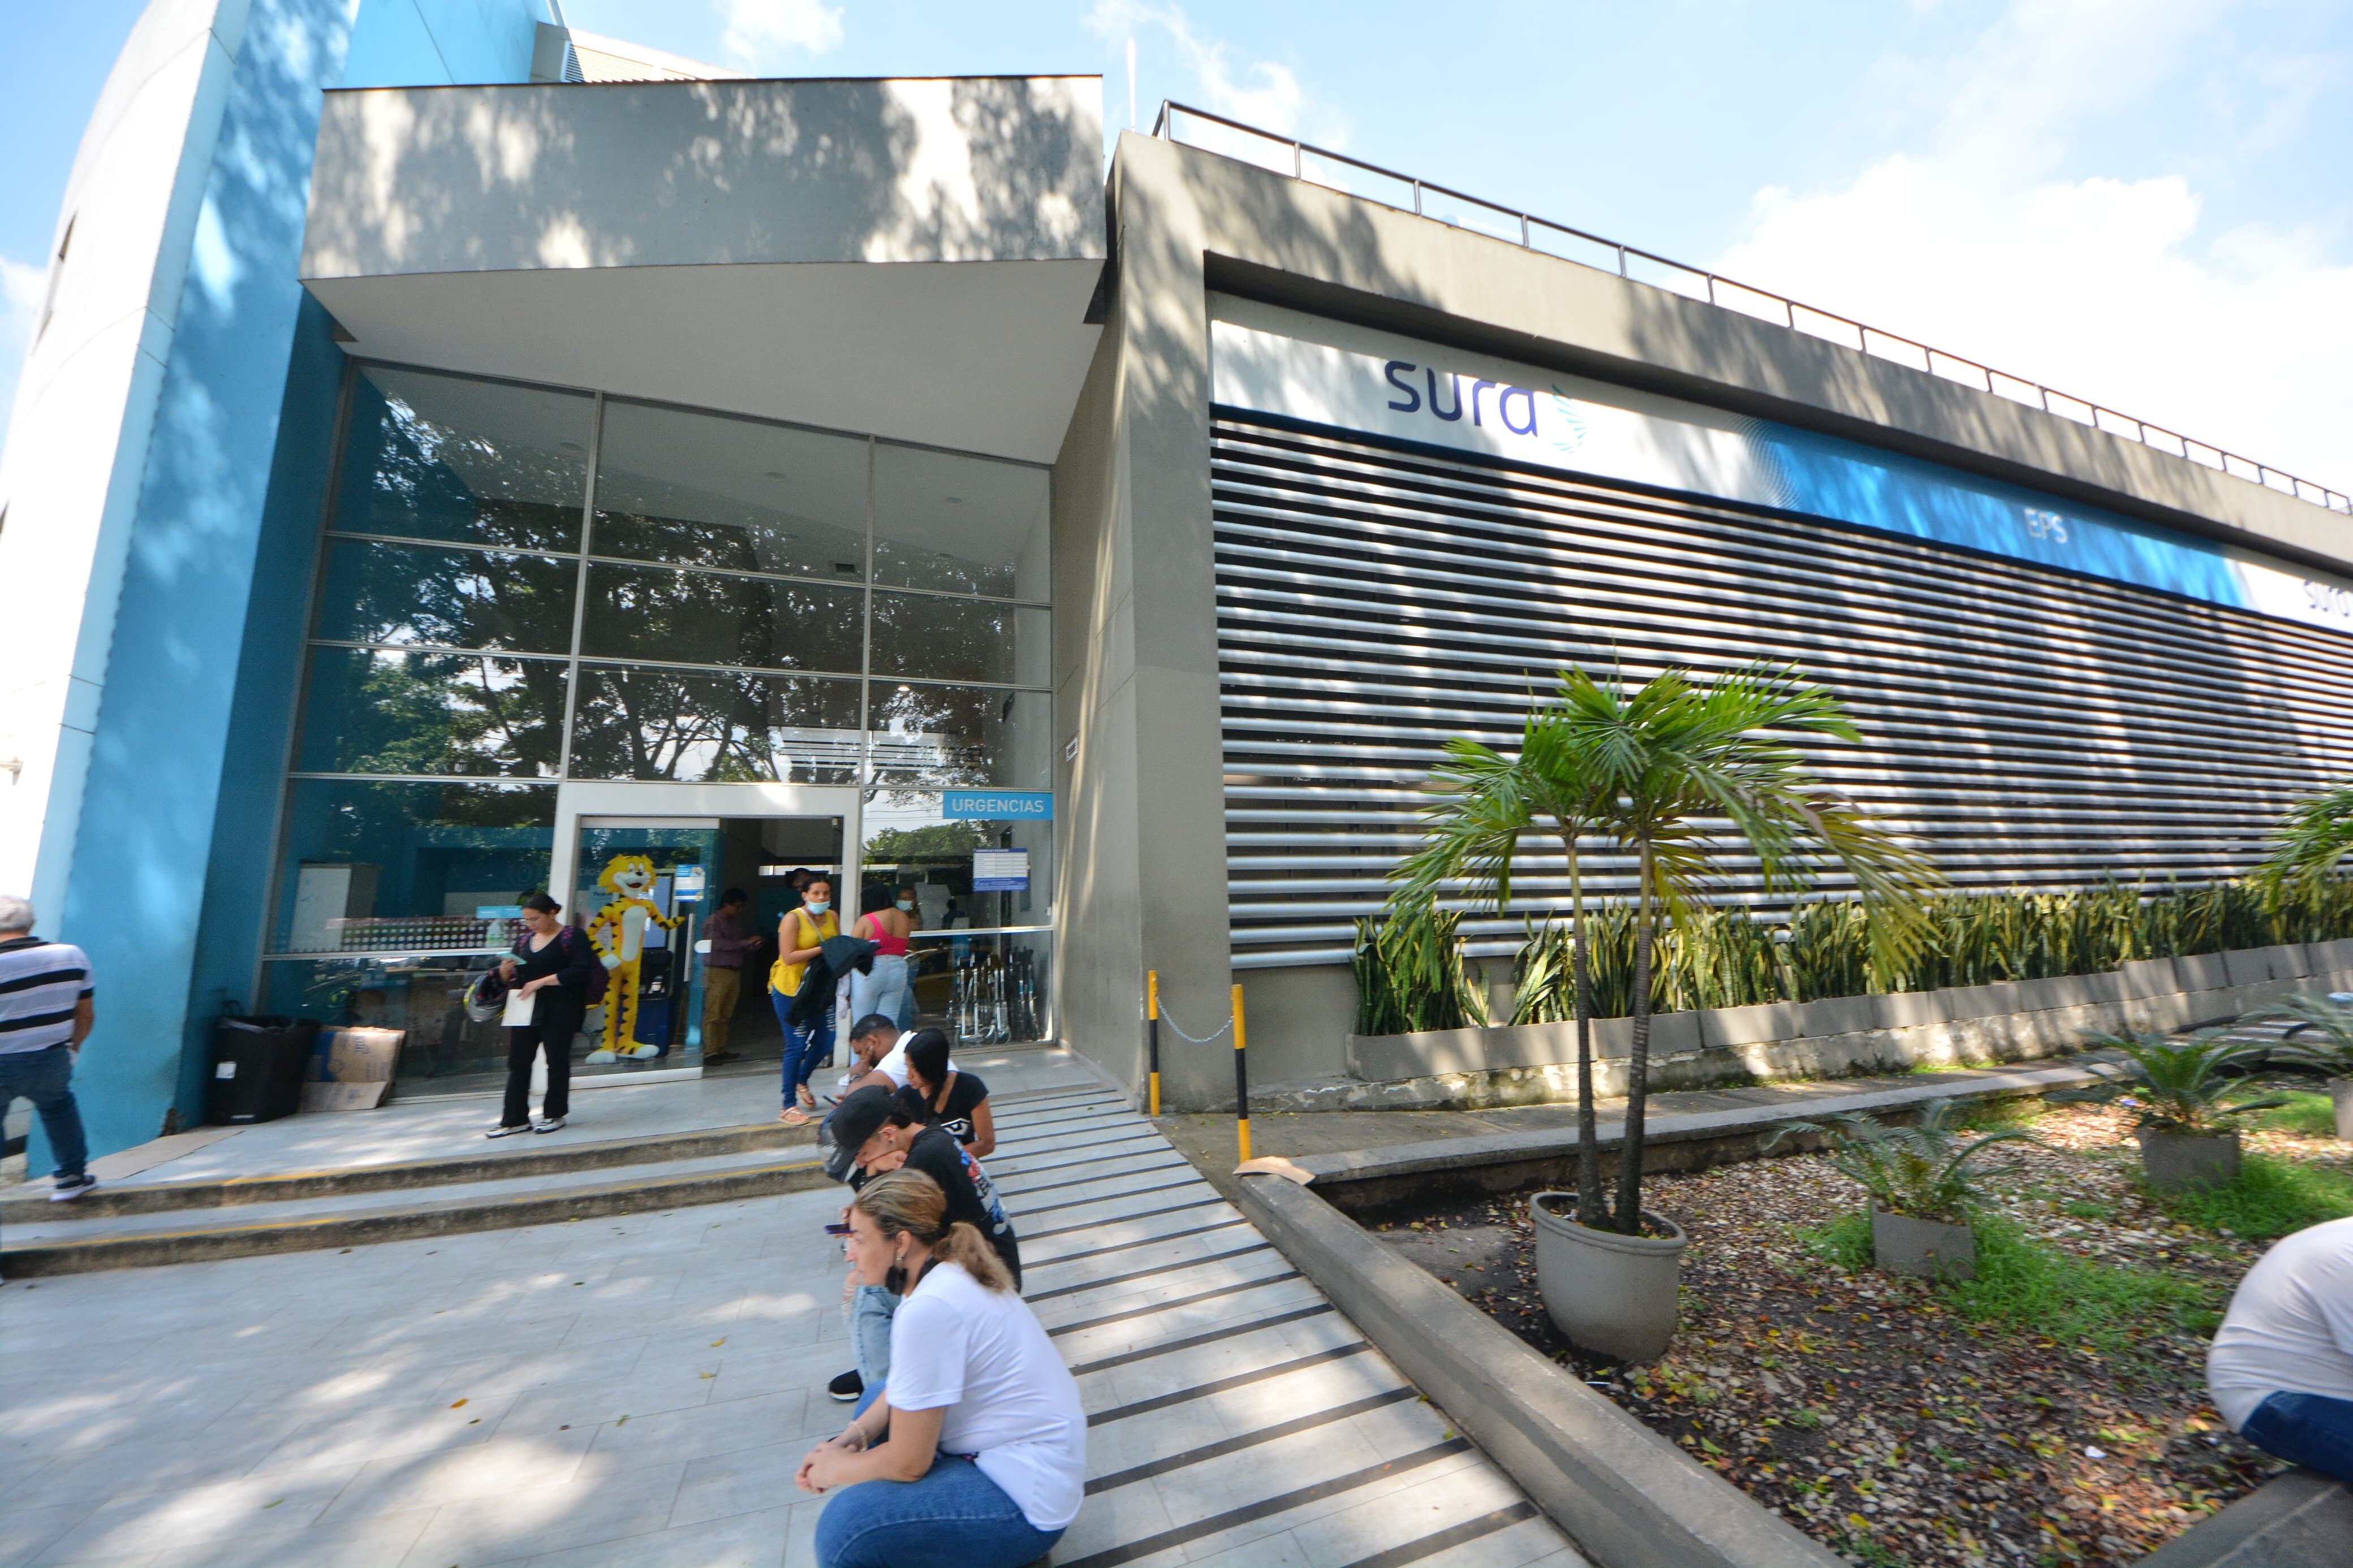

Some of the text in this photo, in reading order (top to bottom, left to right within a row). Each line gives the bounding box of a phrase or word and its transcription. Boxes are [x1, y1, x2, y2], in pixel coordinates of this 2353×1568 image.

[1385, 360, 1538, 437] sura
[2023, 508, 2068, 544] EPS
[952, 798, 1044, 813] URGENCIAS
